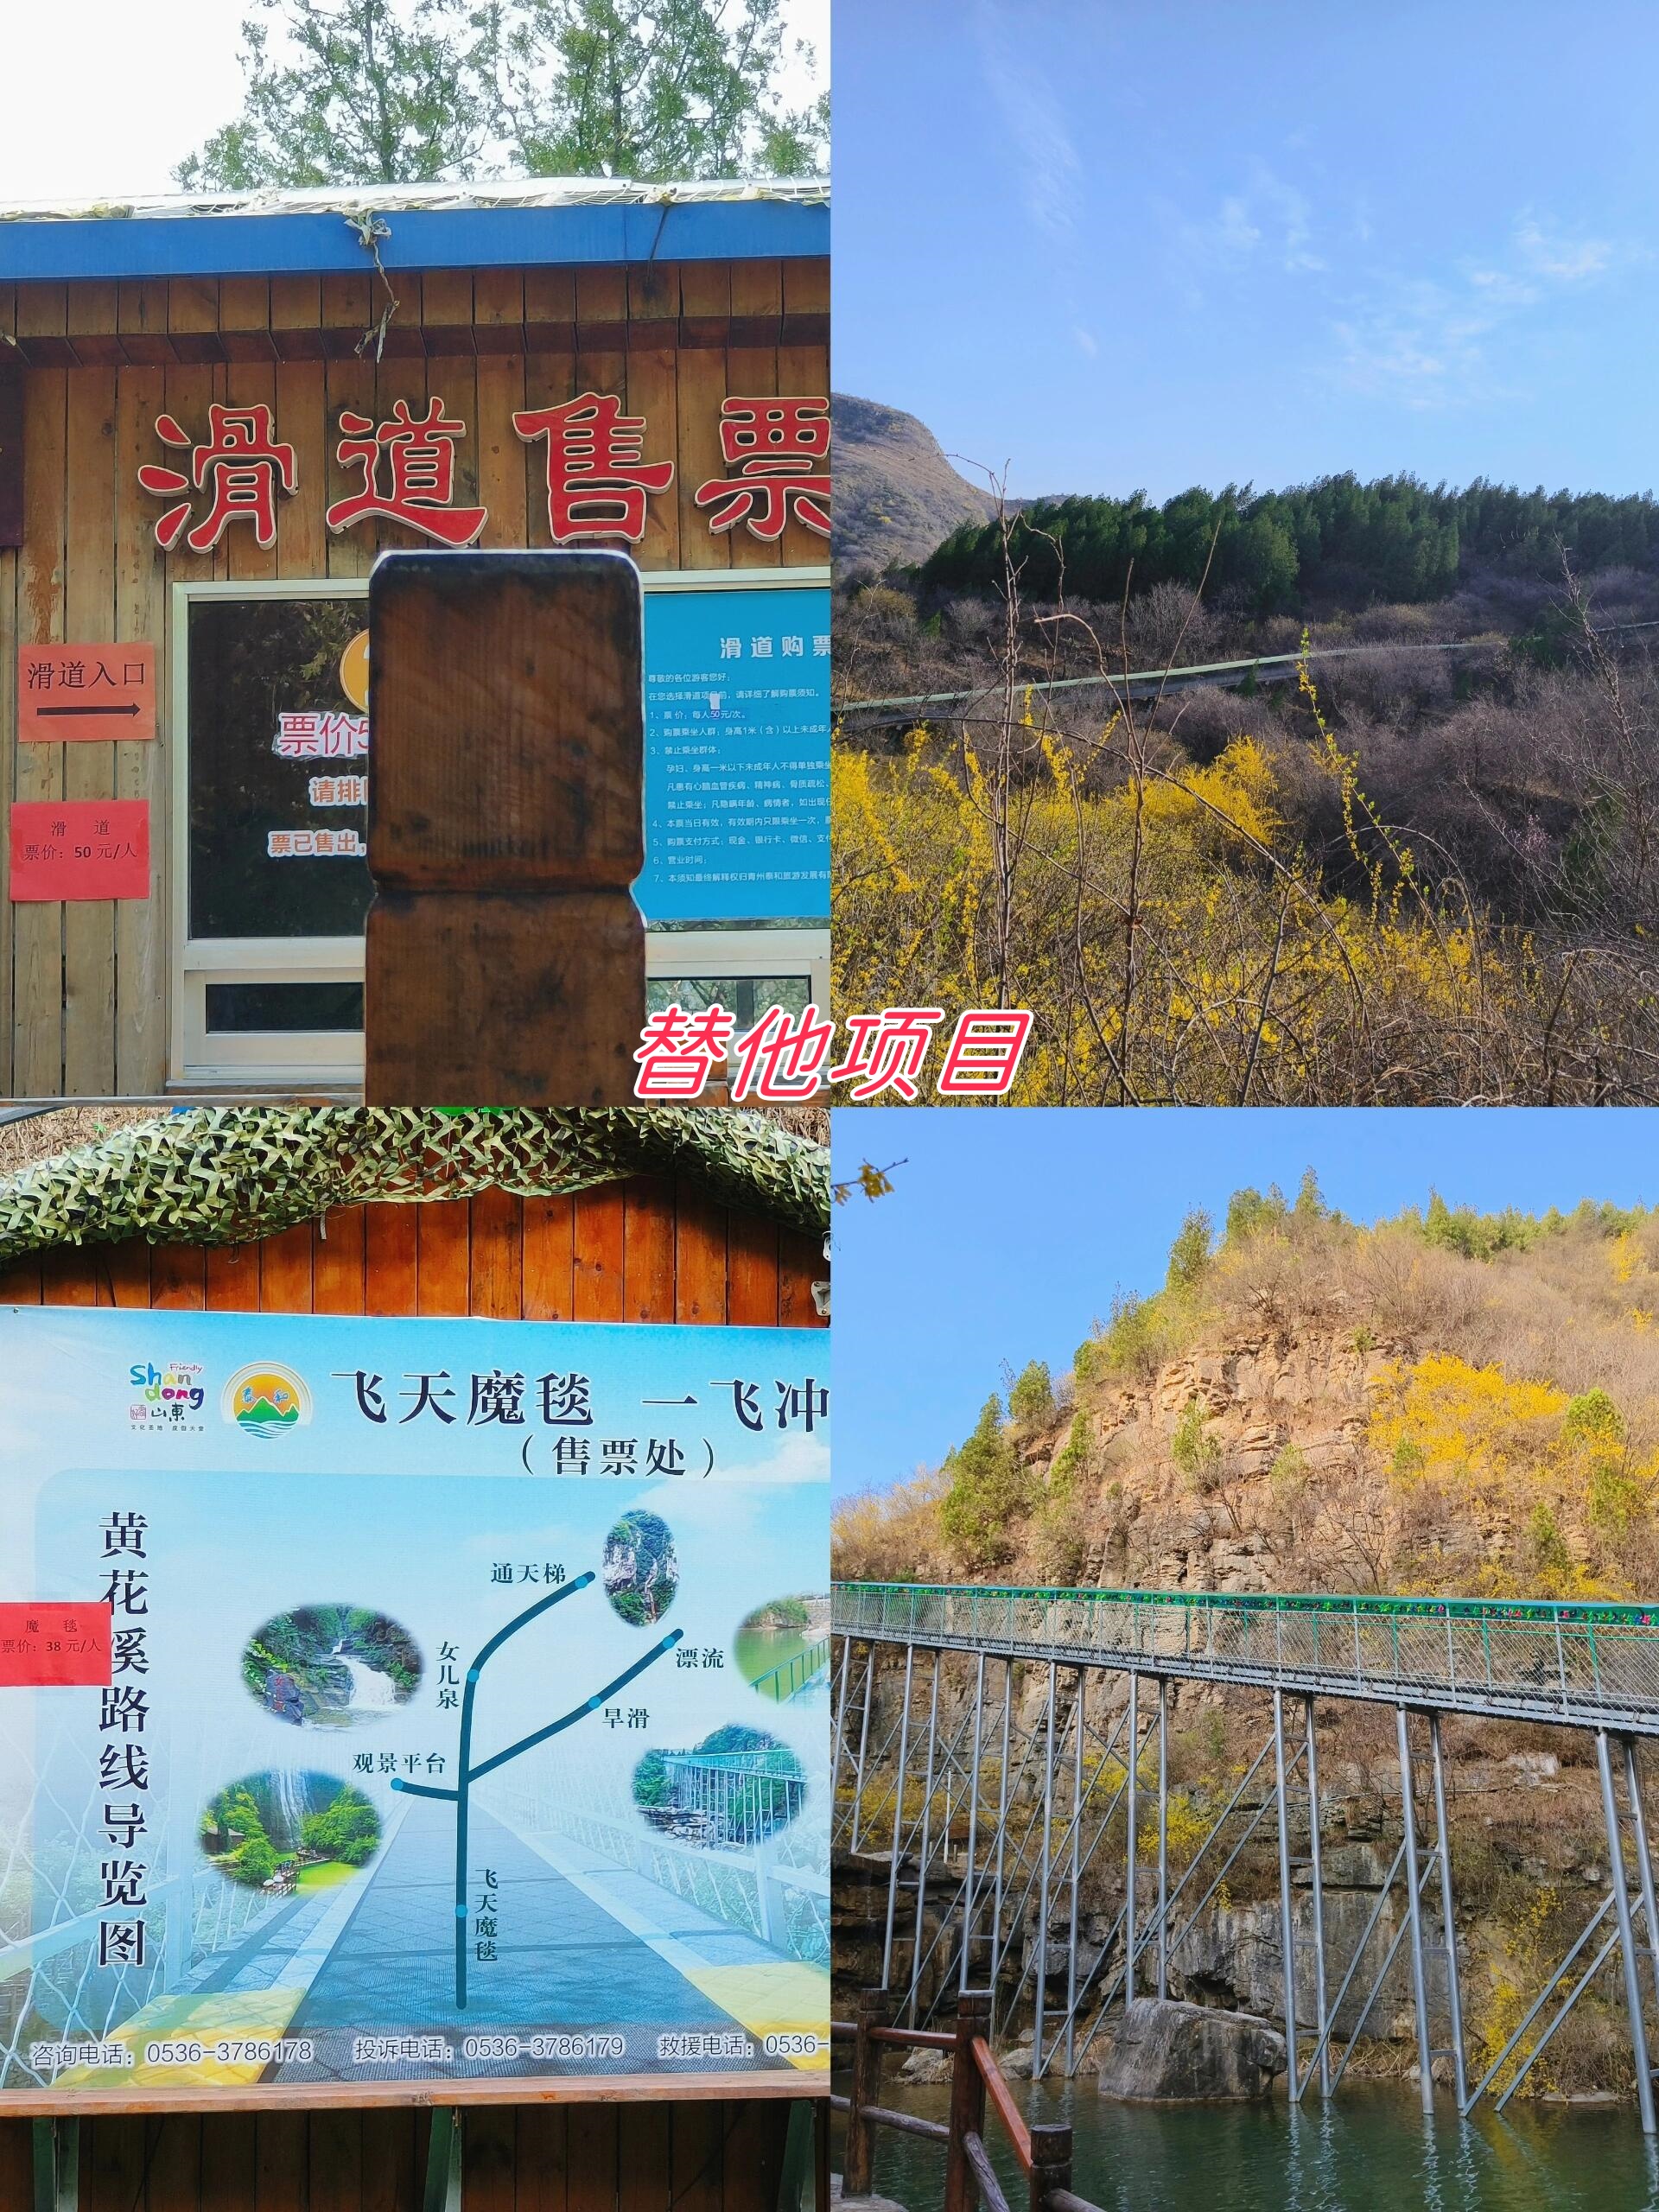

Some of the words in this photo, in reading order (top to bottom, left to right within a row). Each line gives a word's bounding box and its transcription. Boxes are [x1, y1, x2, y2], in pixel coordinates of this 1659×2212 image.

[137, 391, 830, 554] 滑道售票
[720, 635, 830, 658] 滑道购票
[28, 661, 144, 690] 滑道入口
[331, 1370, 594, 1427] 飞天魔毯
[642, 1378, 830, 1433] 一飞冲
[522, 1433, 714, 1478] （售票处）
[491, 1562, 566, 1585] 通天梯
[435, 1641, 460, 1710] 女儿泉
[676, 1648, 724, 1669] 漂流
[602, 1708, 650, 1729] 旱滑
[98, 1511, 149, 1967] 黄花溪路线导览图
[352, 1752, 446, 1775] 观景平台
[474, 1869, 499, 1962] 飞天魔毯
